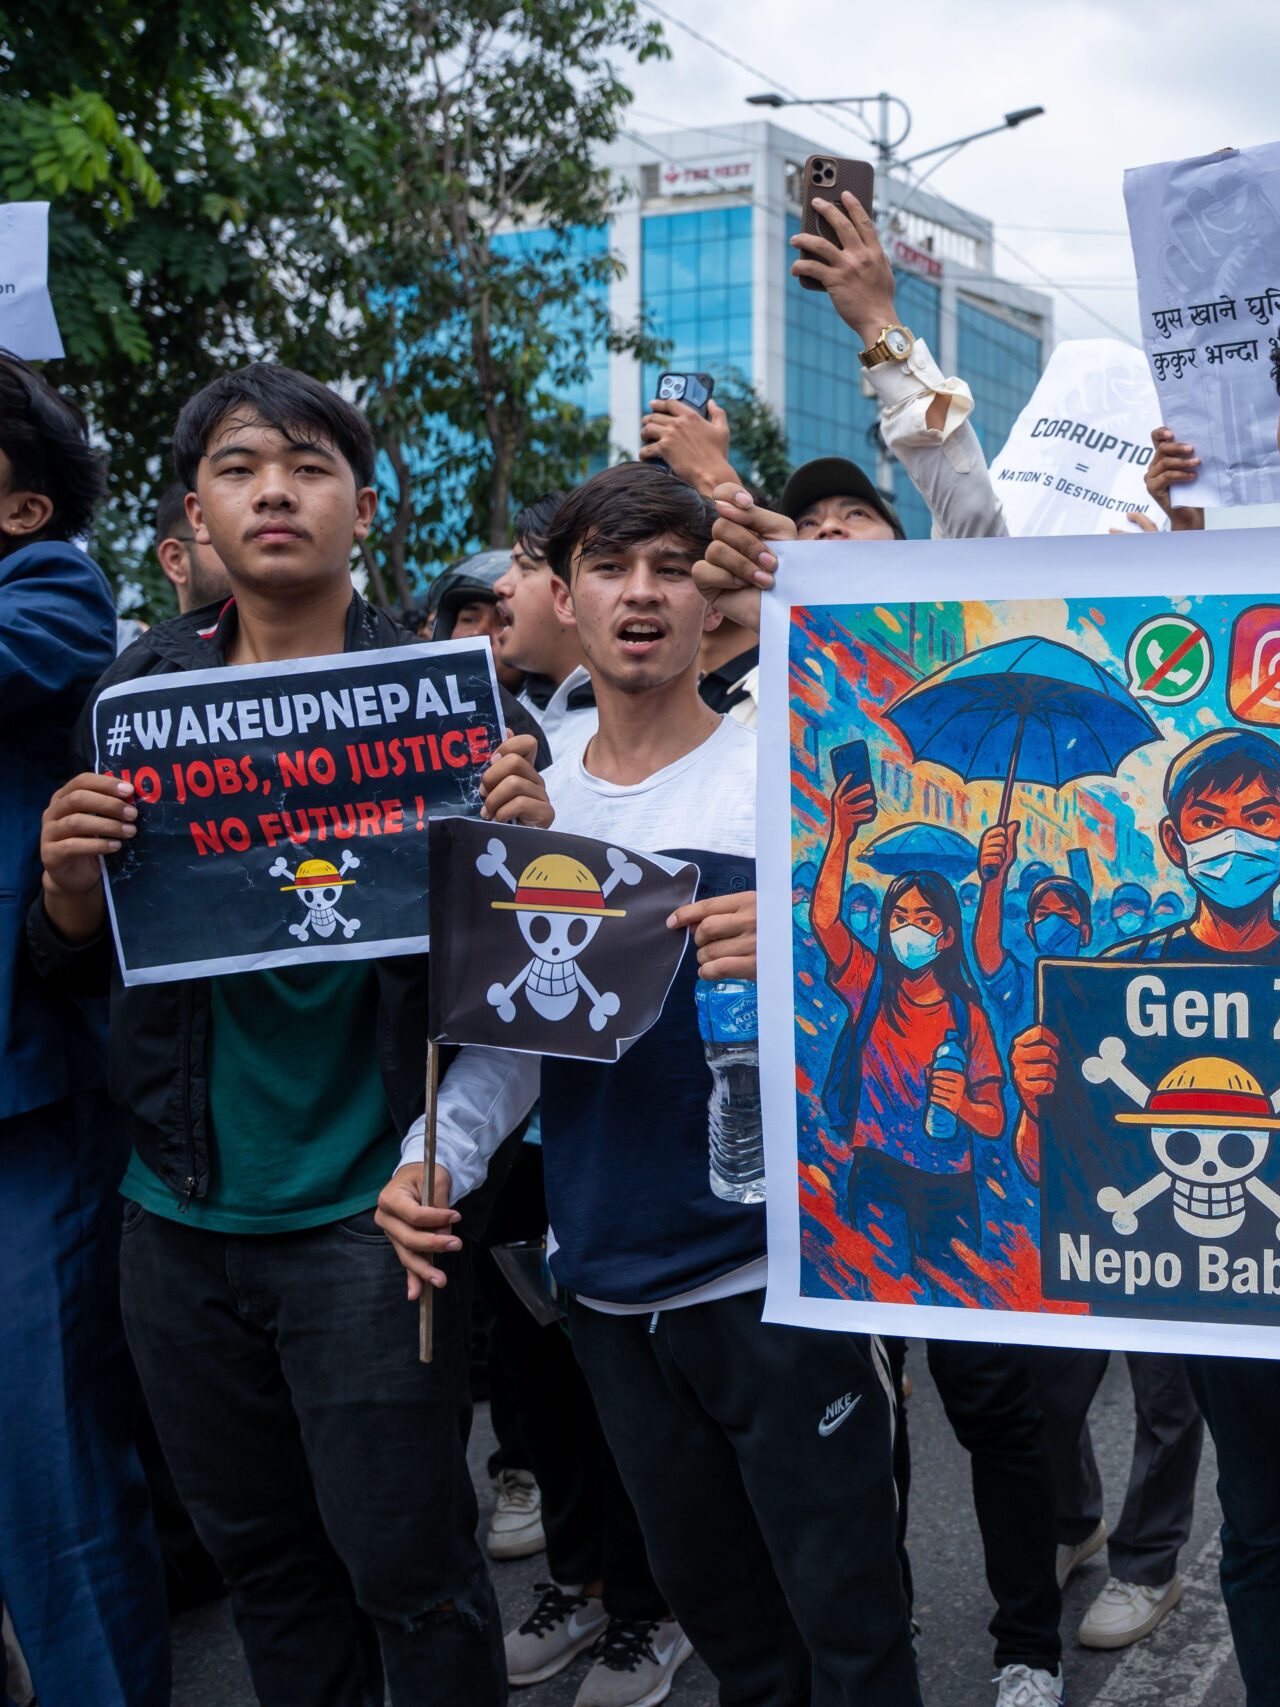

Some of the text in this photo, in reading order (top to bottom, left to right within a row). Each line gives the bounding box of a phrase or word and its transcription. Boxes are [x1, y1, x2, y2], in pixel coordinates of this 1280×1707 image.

[1152, 308, 1183, 339] घुस
[1188, 295, 1237, 326] खाने
[1153, 339, 1259, 381] कुकुर भन्दा
[1031, 418, 1154, 466] CORRUPTIO
[997, 469, 1150, 514] NATION'S DESTRUCTION!
[106, 674, 477, 757] #WAKEUPNEPAL
[174, 754, 270, 805] JOBS,
[277, 747, 337, 787] NO
[348, 726, 492, 785] JUSTICE
[189, 817, 252, 855] NO
[259, 799, 403, 848] FUTURE
[1126, 975, 1249, 1039] Gen
[1059, 1232, 1182, 1295] Nepo
[826, 1392, 852, 1420] NIKE
